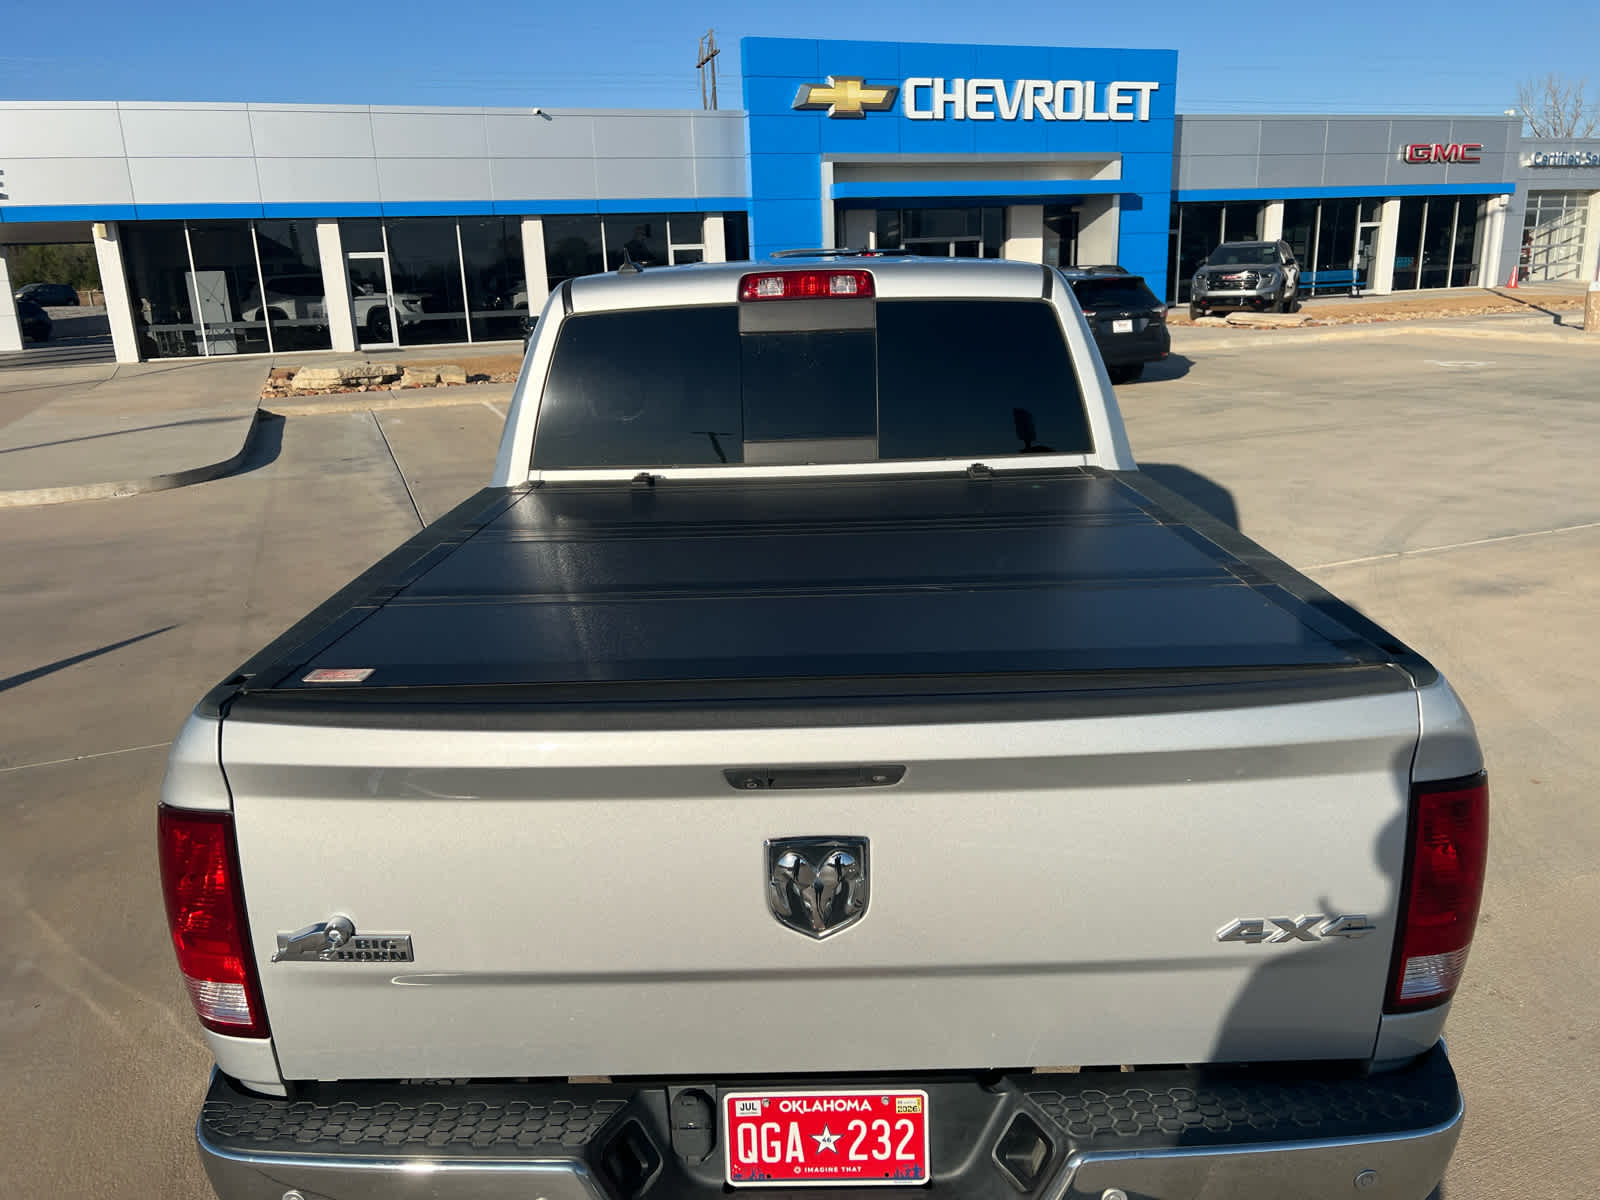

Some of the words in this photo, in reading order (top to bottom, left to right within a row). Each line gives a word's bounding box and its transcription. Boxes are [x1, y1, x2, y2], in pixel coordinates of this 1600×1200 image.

[903, 77, 1159, 121] CHEVROLET
[1405, 143, 1482, 163] GMC
[1533, 151, 1581, 167] Certified
[1585, 151, 1600, 167] Se
[355, 939, 397, 949] BIG
[338, 951, 408, 960] HORN
[740, 1102, 757, 1111] JUL
[779, 1098, 872, 1114] OKLAHOMA
[897, 1105, 918, 1113] 2026
[737, 1121, 805, 1164] QGA
[847, 1119, 915, 1161] 232
[841, 1165, 862, 1173] THAT
